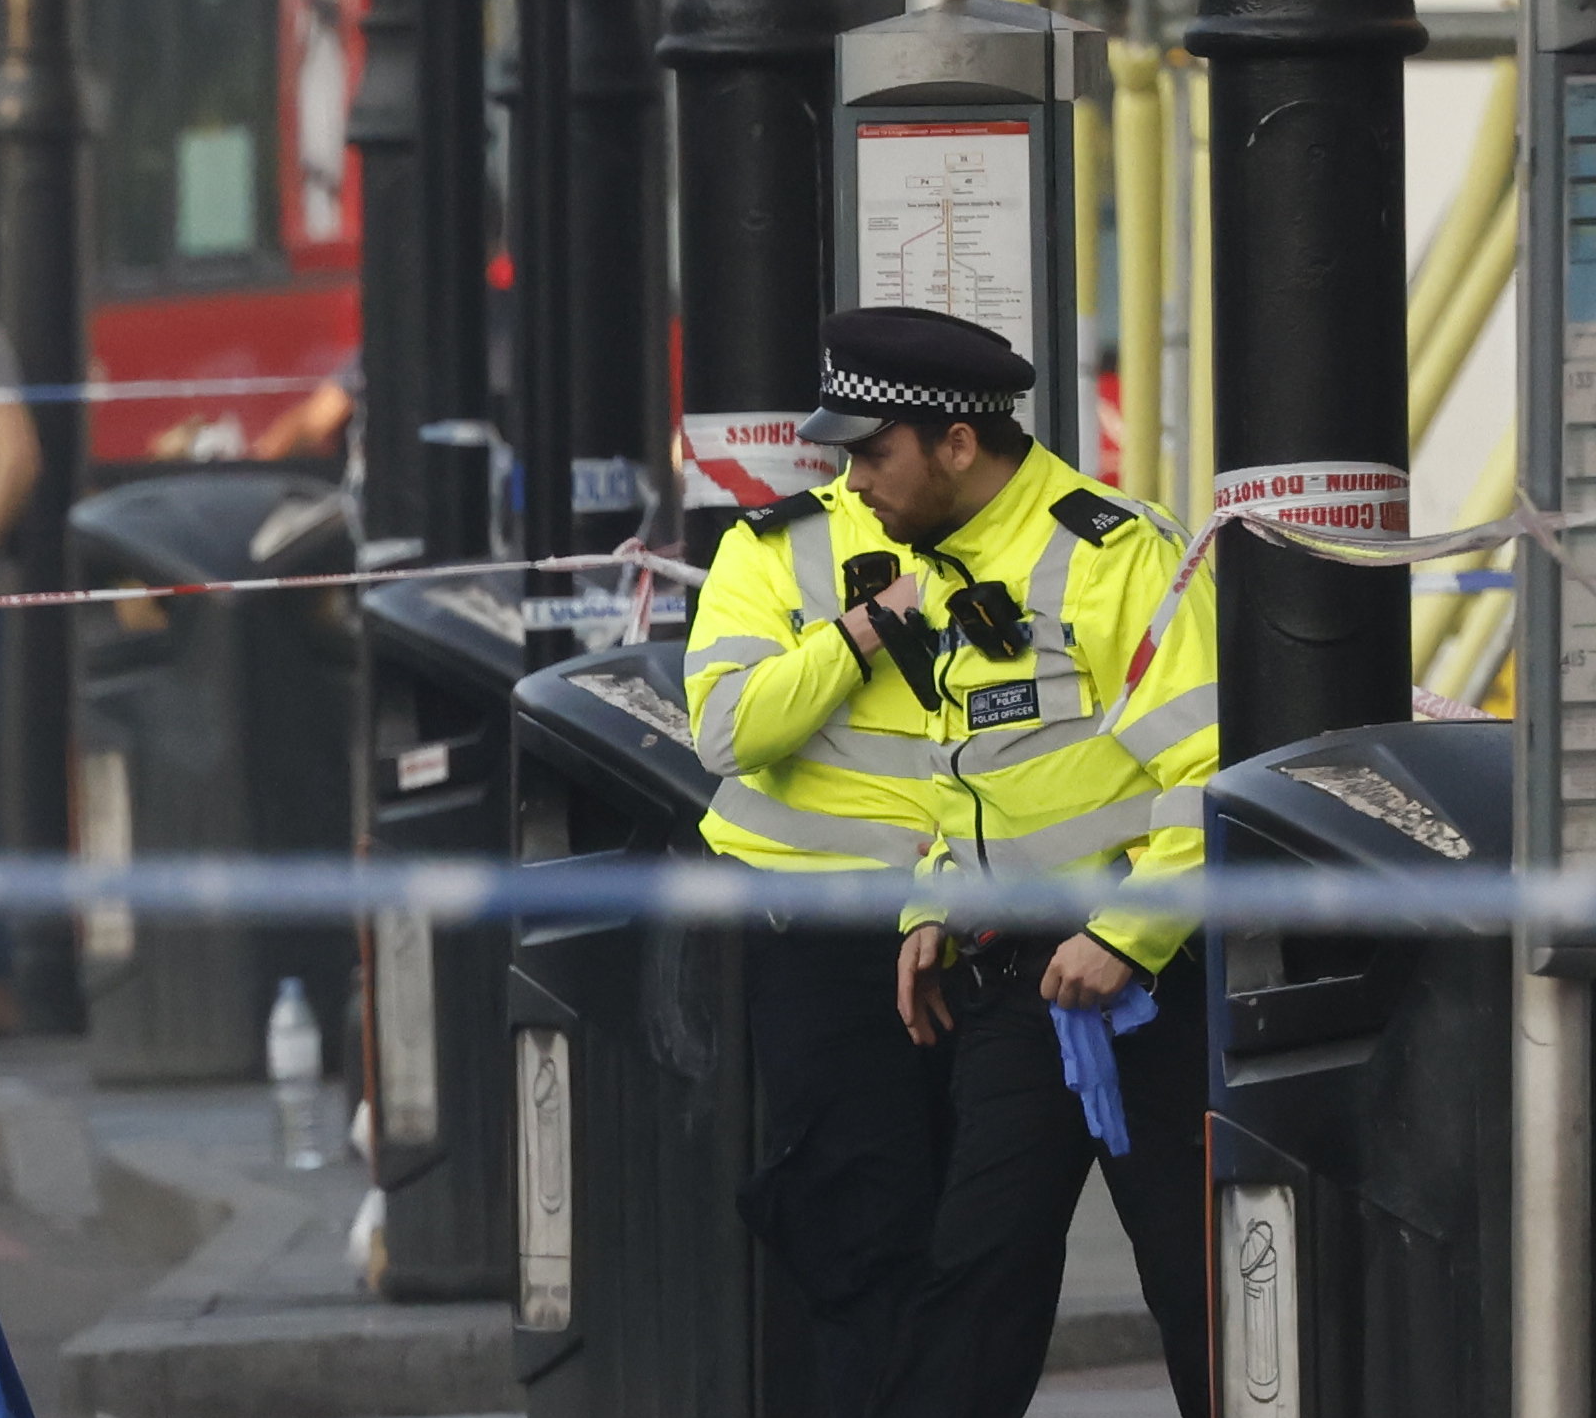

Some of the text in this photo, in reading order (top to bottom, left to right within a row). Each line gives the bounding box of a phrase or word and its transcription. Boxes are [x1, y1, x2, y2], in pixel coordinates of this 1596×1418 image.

[725, 420, 797, 445] CROSS
[1235, 479, 1265, 504] NOT
[1271, 474, 1305, 497] DO
[996, 693, 1023, 706] POLICE
[972, 705, 1034, 725] POLICE OFFICER
